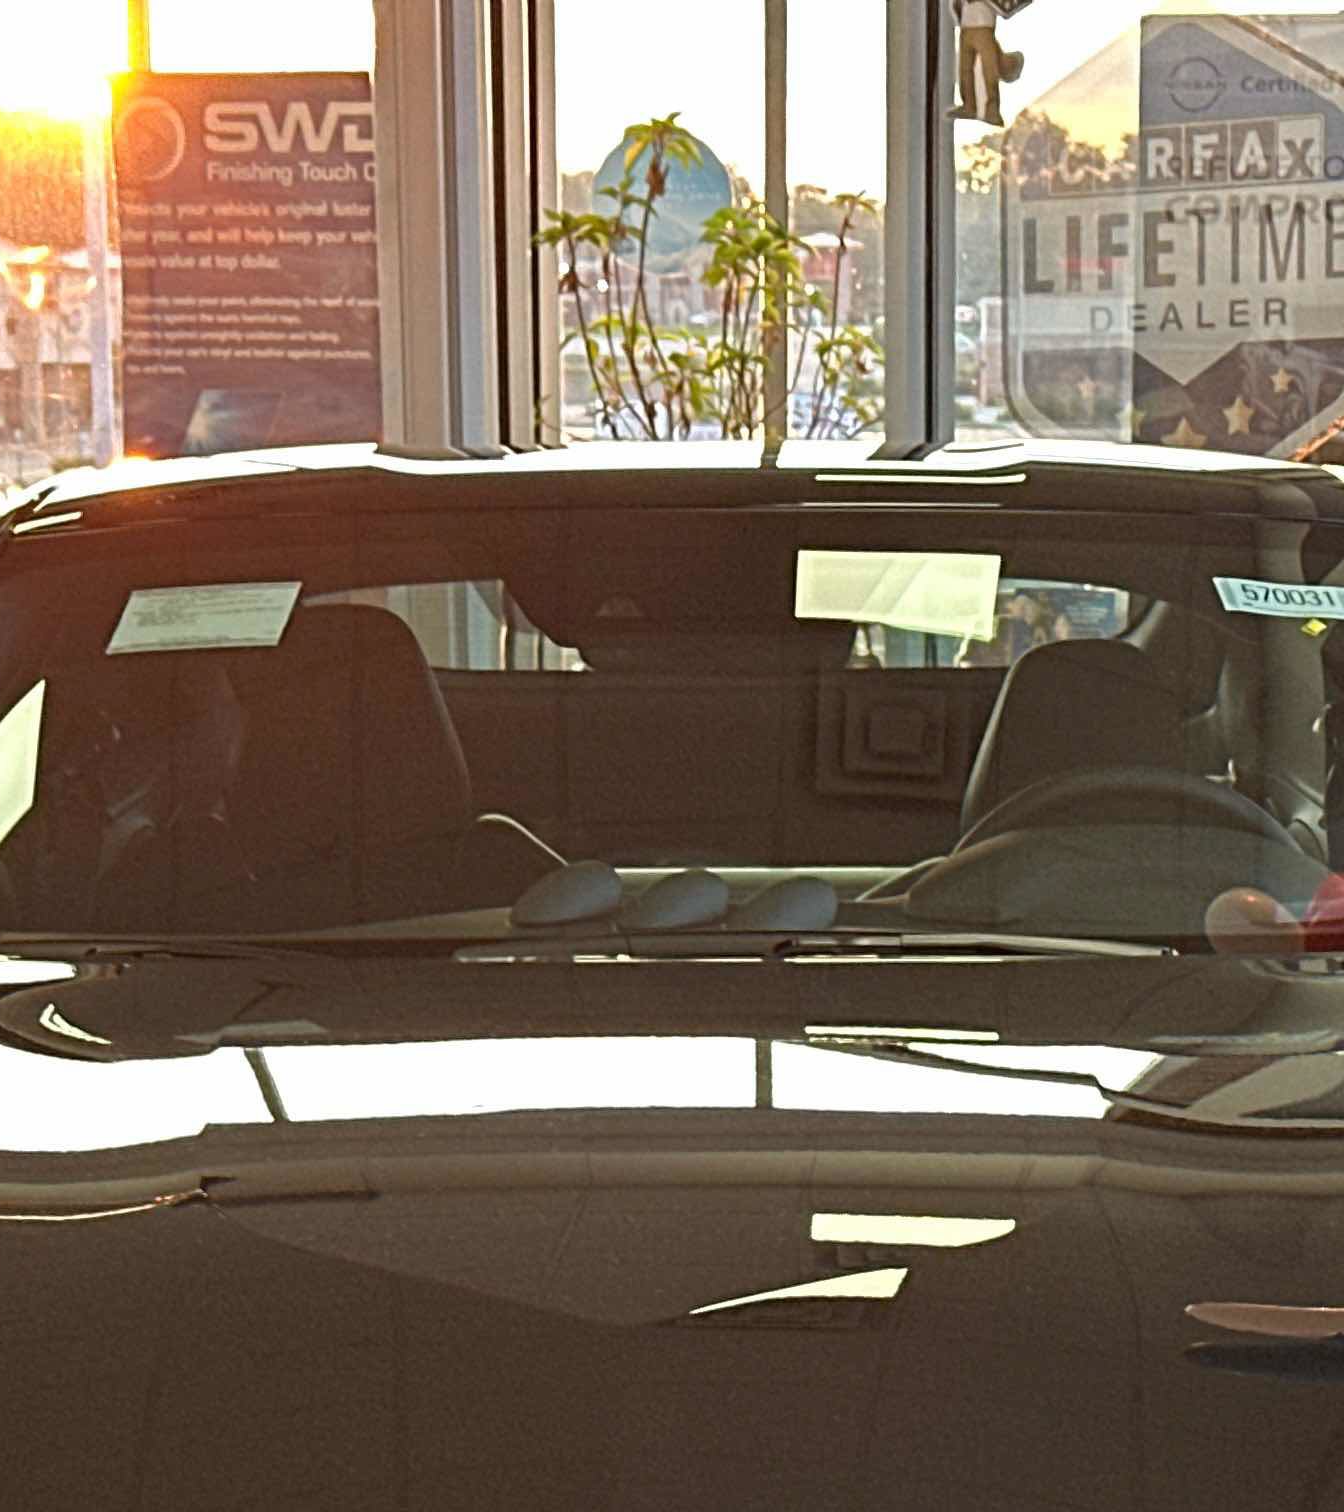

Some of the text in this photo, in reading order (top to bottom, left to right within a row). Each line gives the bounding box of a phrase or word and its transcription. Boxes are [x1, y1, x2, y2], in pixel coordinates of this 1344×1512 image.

[207, 161, 293, 187] Finishing
[299, 162, 357, 182] Touch
[1090, 298, 1289, 334] DEALER
[1241, 583, 1336, 607] 570031
